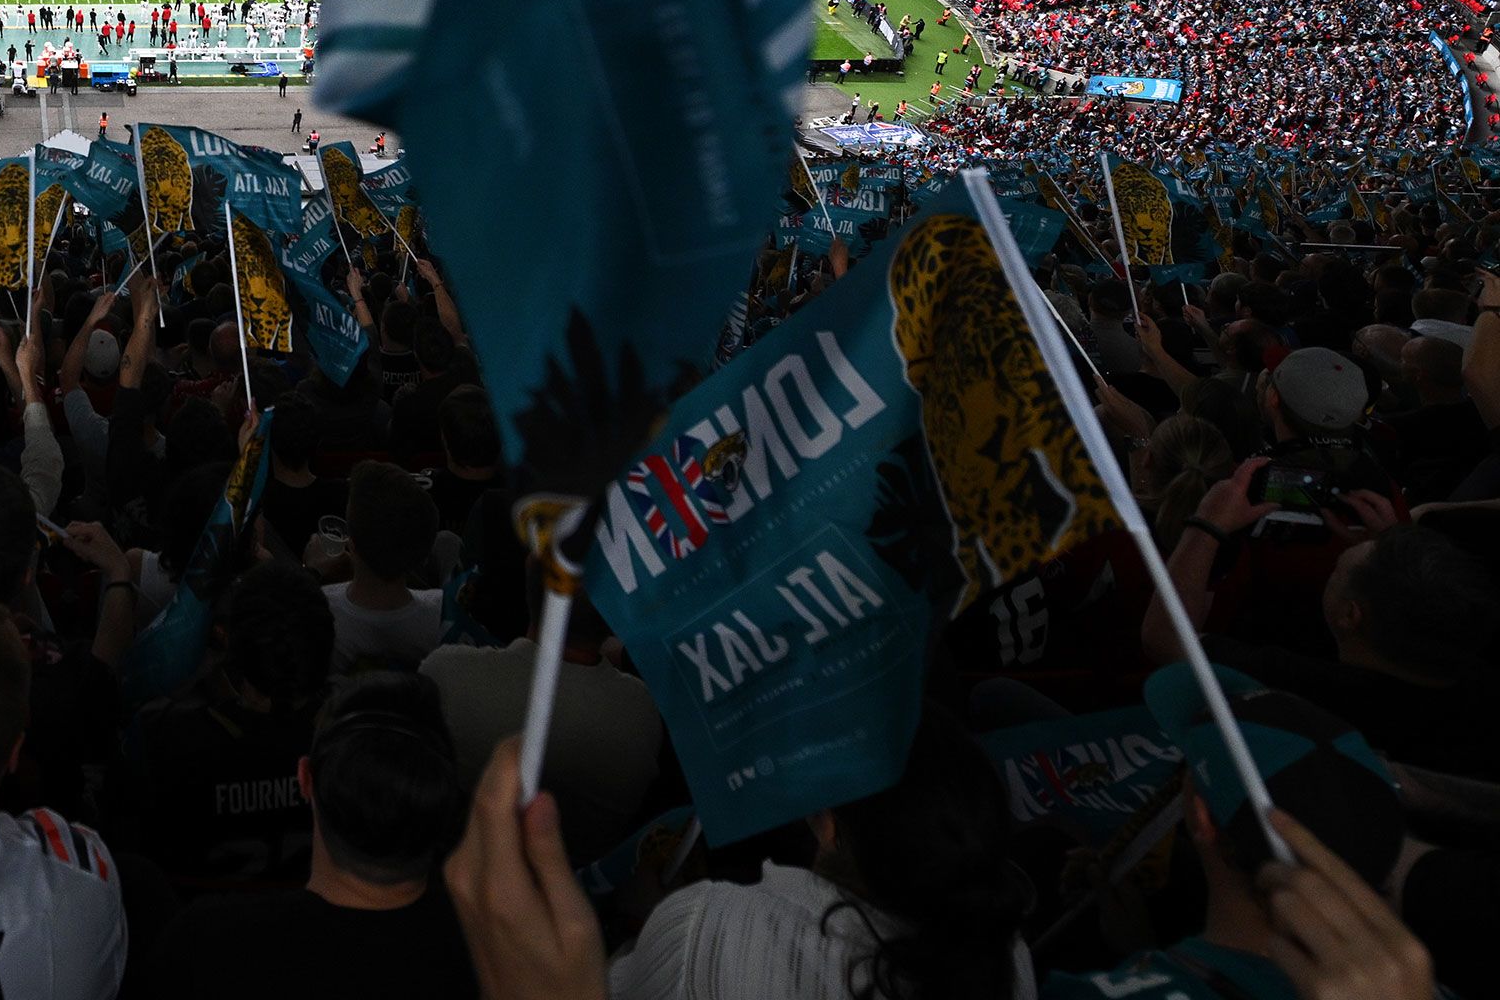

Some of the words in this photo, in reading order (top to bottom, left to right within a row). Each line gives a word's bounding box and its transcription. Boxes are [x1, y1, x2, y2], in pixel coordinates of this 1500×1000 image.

[234, 173, 260, 193] ATL
[264, 177, 290, 198] JAX
[988, 576, 1049, 665] 16
